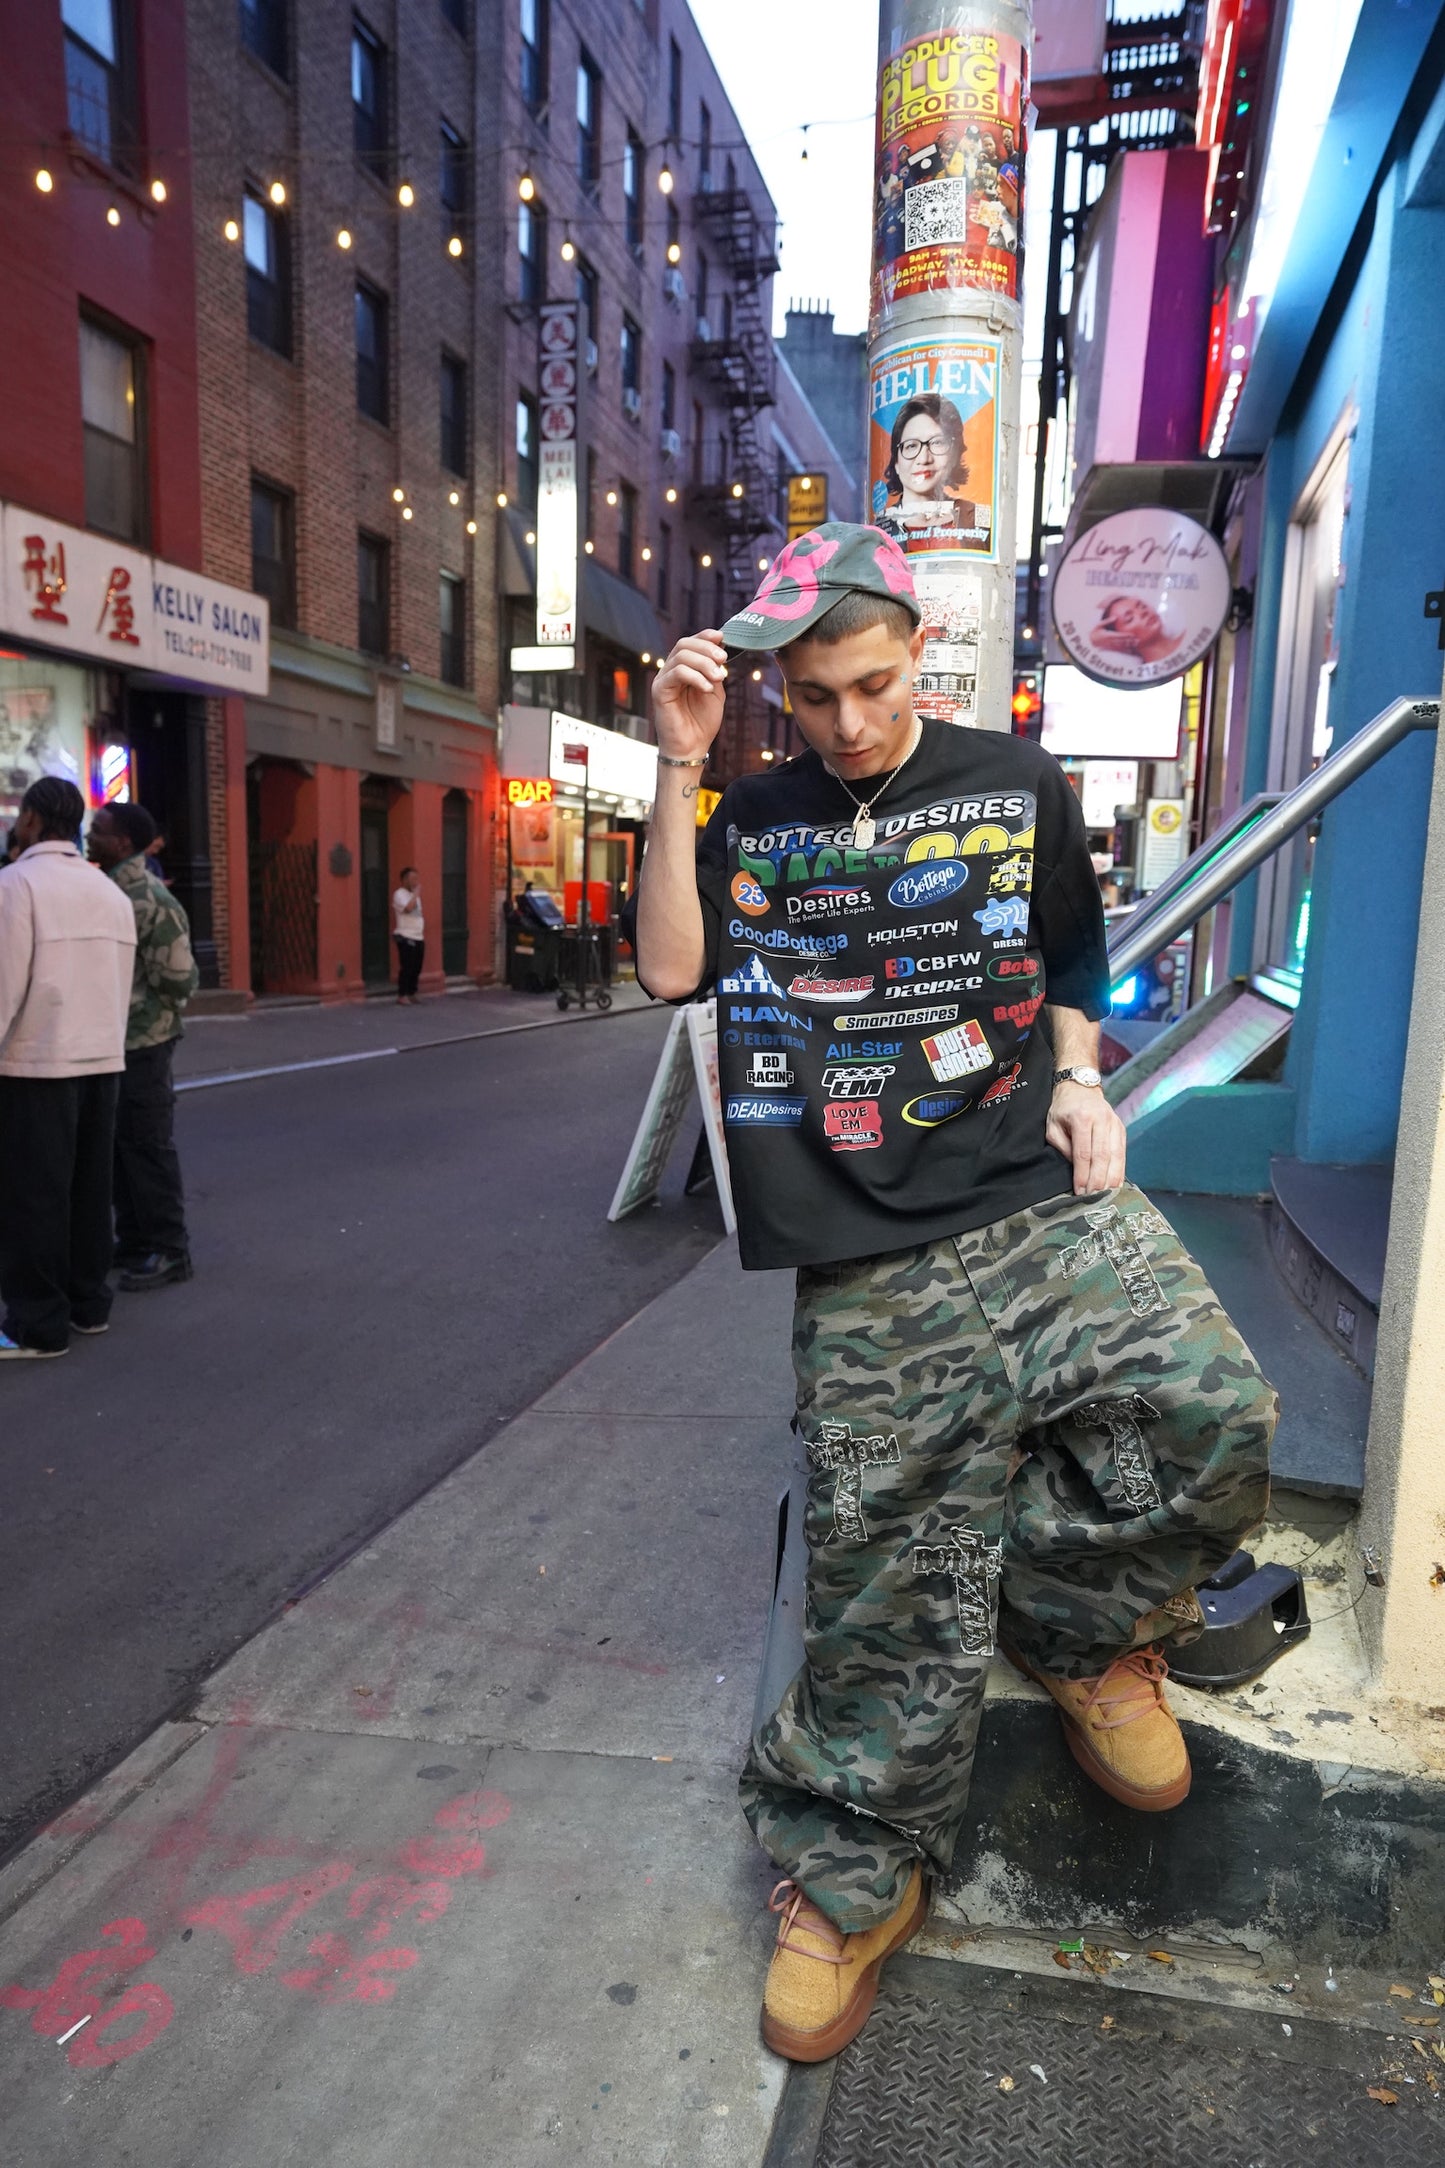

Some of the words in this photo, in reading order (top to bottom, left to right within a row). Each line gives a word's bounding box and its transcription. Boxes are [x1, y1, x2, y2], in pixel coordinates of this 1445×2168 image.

[883, 36, 998, 87] PRODUCER
[883, 54, 998, 121] PLUG
[884, 92, 995, 139] RECORDS
[909, 250, 930, 264] 9AM
[981, 260, 1008, 276] 10002
[913, 351, 926, 361] for
[928, 347, 947, 361] City
[949, 347, 983, 358] Council
[871, 359, 997, 414] HELEN
[933, 526, 990, 543] Prosperity
[1071, 530, 1134, 573] Ling
[152, 580, 204, 625] KELLY
[212, 603, 262, 645] SALON
[1070, 635, 1092, 659] Pell
[1090, 654, 1125, 676] Street
[508, 780, 552, 803] BAR
[740, 826, 873, 854] BOTTEG
[884, 796, 1026, 839] DESIRES
[737, 881, 767, 907] 23
[897, 866, 957, 905] Bottega
[917, 882, 958, 904] Cabinetry
[786, 890, 872, 916] Desires
[787, 914, 801, 925] The
[802, 912, 825, 922] Better
[827, 908, 841, 918] Life
[843, 905, 875, 916] Experts
[728, 919, 849, 955] GoodBottega
[867, 919, 960, 945] HOUSTON
[916, 951, 982, 973] CBFW
[791, 975, 876, 995] DESIRE
[729, 1006, 813, 1032] HAVIN
[846, 1007, 957, 1029] SmartDesires
[744, 1032, 807, 1051] Eternal
[825, 1040, 903, 1059] All-Star
[933, 1025, 972, 1059] RUFF
[762, 1056, 780, 1068] BD
[931, 1042, 994, 1082] RYDERS
[747, 1071, 795, 1085] RACING
[830, 1077, 885, 1098] EM
[832, 1106, 868, 1119] LOVE
[840, 1132, 871, 1140] MIRACLE
[842, 1120, 862, 1130] EM
